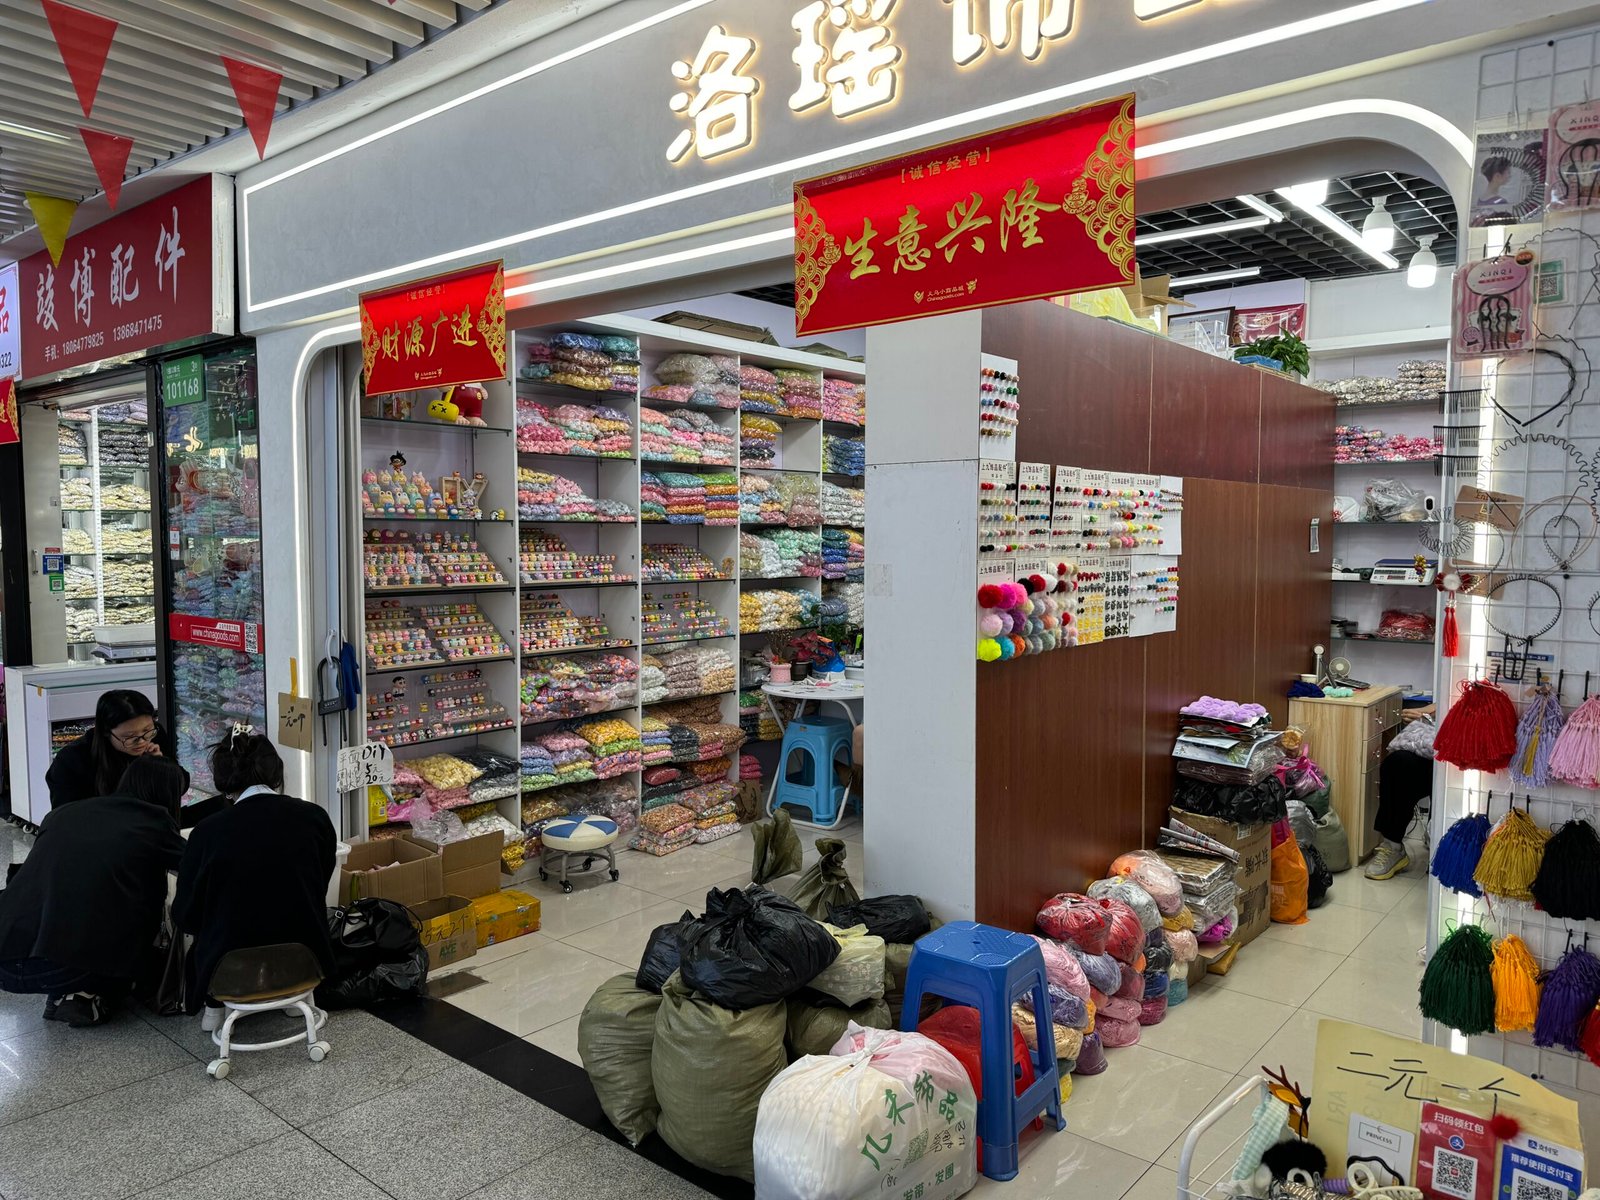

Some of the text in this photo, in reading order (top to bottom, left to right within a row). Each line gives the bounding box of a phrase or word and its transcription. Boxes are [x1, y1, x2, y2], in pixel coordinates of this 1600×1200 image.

[666, 0, 1203, 162] 洛瑶
[843, 177, 1062, 281] 生意兴隆
[113, 314, 163, 342] 13868471475
[382, 303, 478, 362] 财源广进
[0, 351, 12, 369] 322
[166, 377, 199, 400] 101168
[192, 628, 239, 642] www.chinagoods.com
[1336, 1051, 1522, 1119] 二元一个
[1434, 1111, 1486, 1135] 扫码领红包
[1366, 1131, 1393, 1146] PRINCESS
[1538, 1143, 1560, 1157] 支付宝
[1510, 1152, 1575, 1183] 推荐使用支付宝
